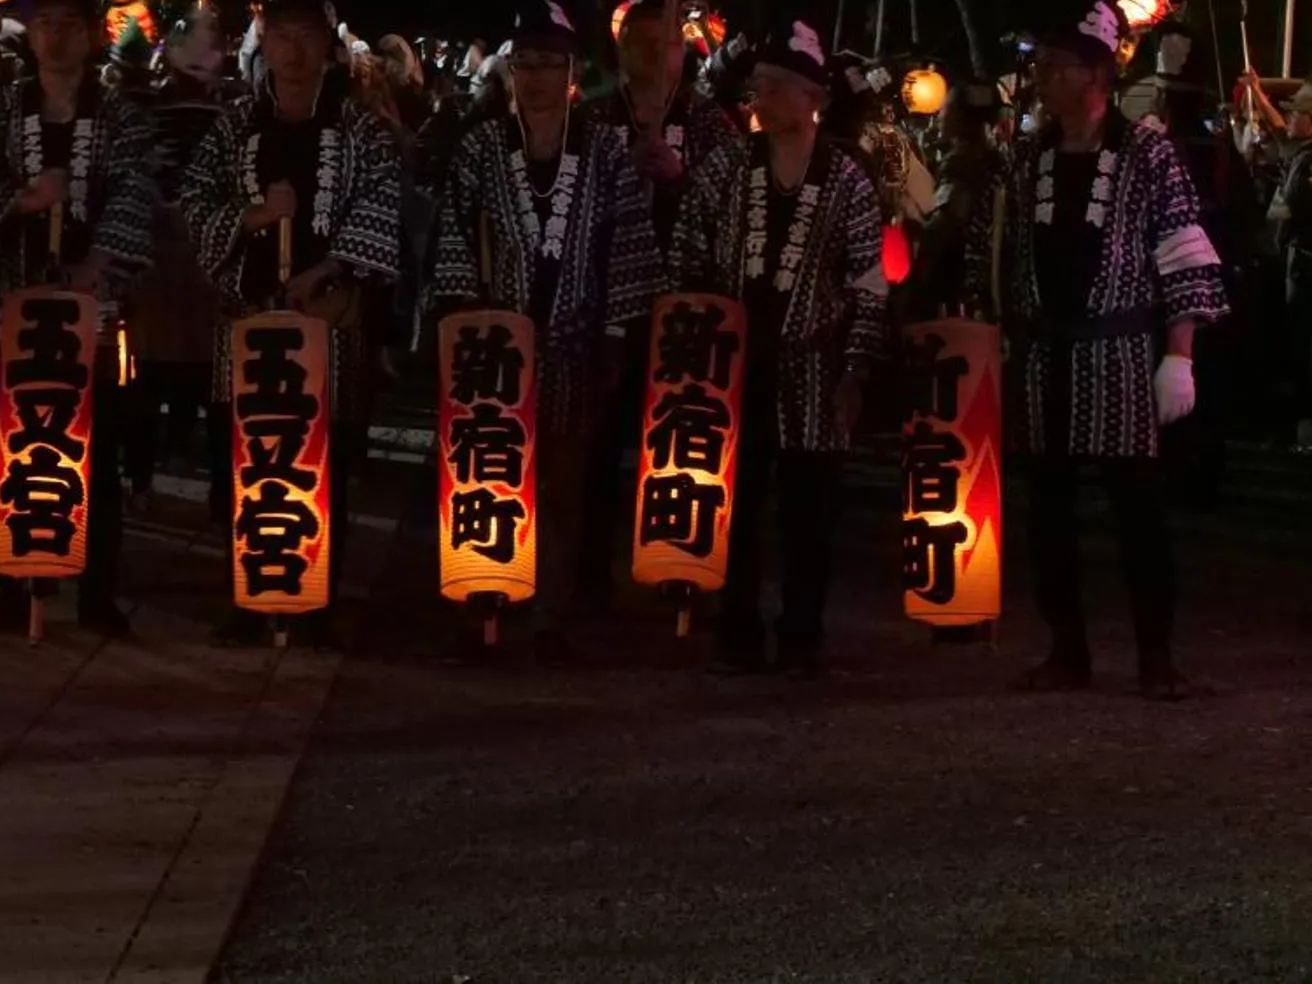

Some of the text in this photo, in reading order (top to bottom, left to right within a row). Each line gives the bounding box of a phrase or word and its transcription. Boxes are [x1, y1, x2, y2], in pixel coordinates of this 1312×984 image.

[449, 325, 526, 564] 新宿町
[639, 300, 742, 558] 新宿町
